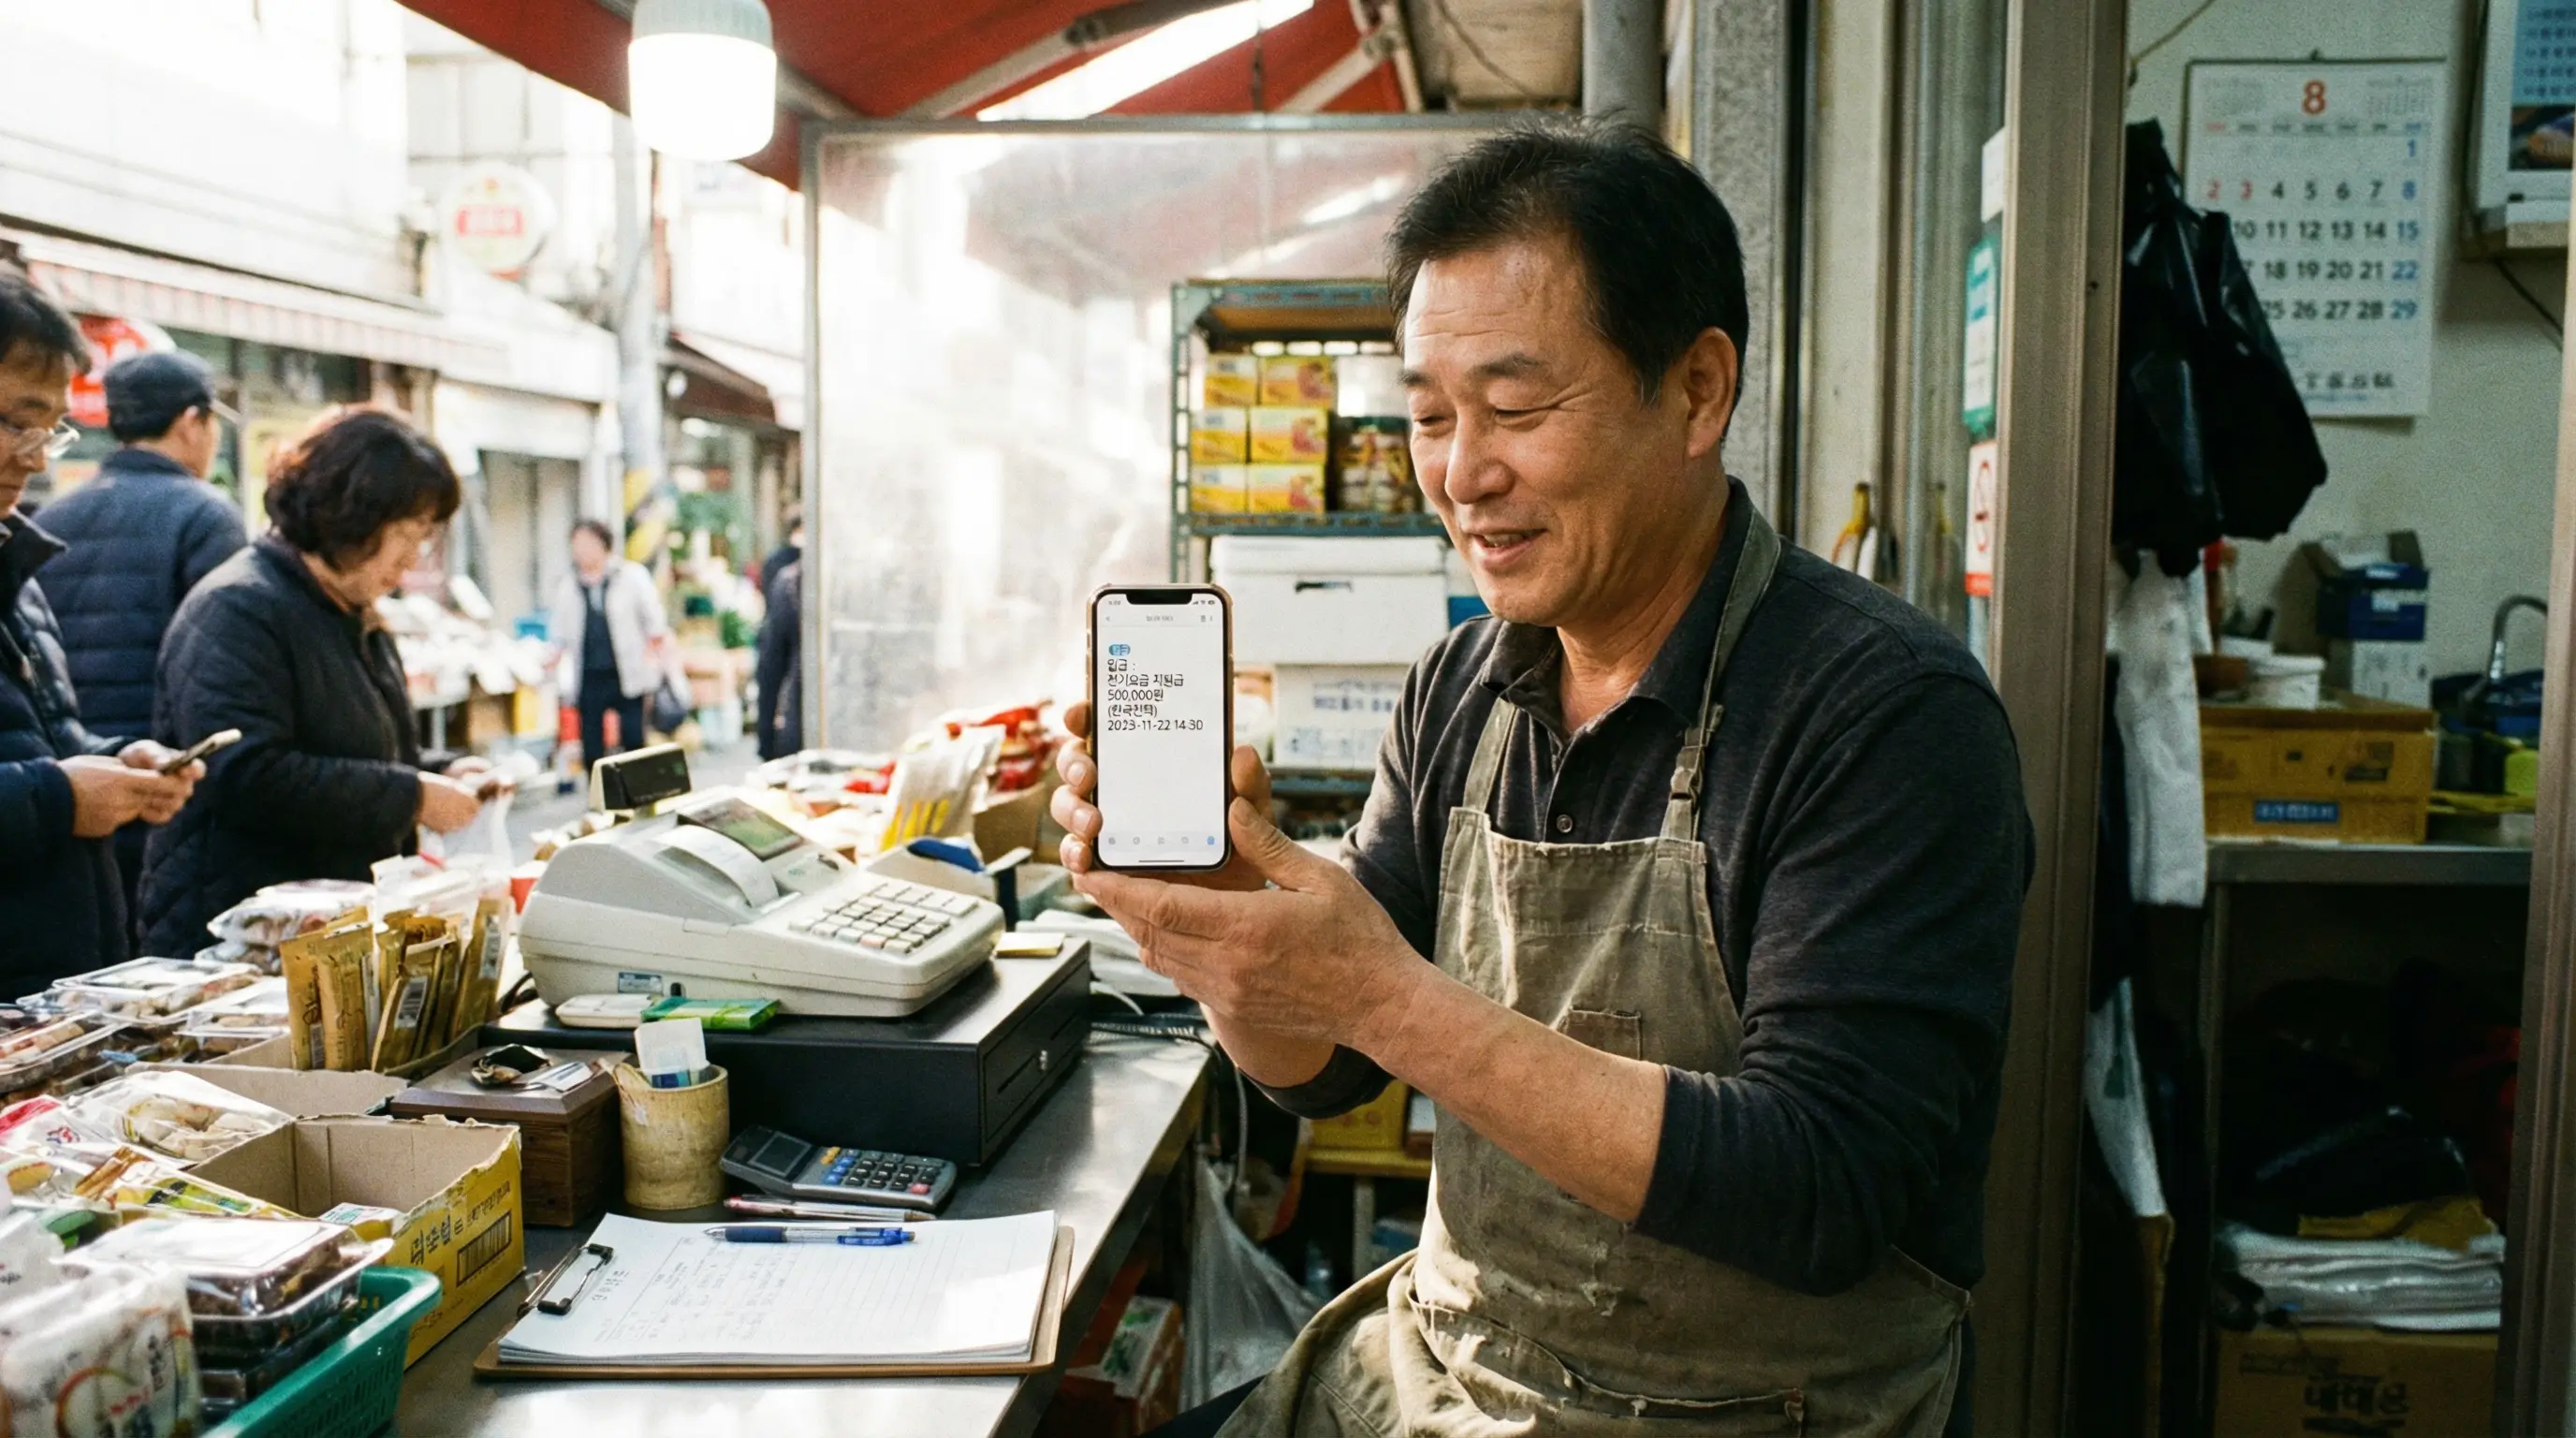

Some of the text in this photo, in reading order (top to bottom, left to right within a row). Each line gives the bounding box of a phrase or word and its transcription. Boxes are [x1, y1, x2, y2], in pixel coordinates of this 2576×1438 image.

[2303, 80, 2327, 116] 8
[2408, 139, 2416, 157] 1
[2207, 180, 2416, 200] 2 3 4 5 6 7 8
[2266, 221, 2287, 238] 11
[2299, 221, 2321, 240] 12
[2331, 221, 2353, 240] 13
[2364, 222, 2386, 239] 14
[2397, 221, 2419, 240] 15
[2265, 260, 2287, 280] 18
[2297, 260, 2320, 279] 19
[2326, 260, 2353, 280] 20
[2360, 260, 2383, 280] 21
[2392, 260, 2419, 279] 22
[2292, 300, 2318, 320] 26
[2324, 300, 2350, 320] 27
[2357, 300, 2383, 320] 28
[2391, 300, 2419, 320] 29
[1107, 720, 1204, 730] 2023-11-22 1430
